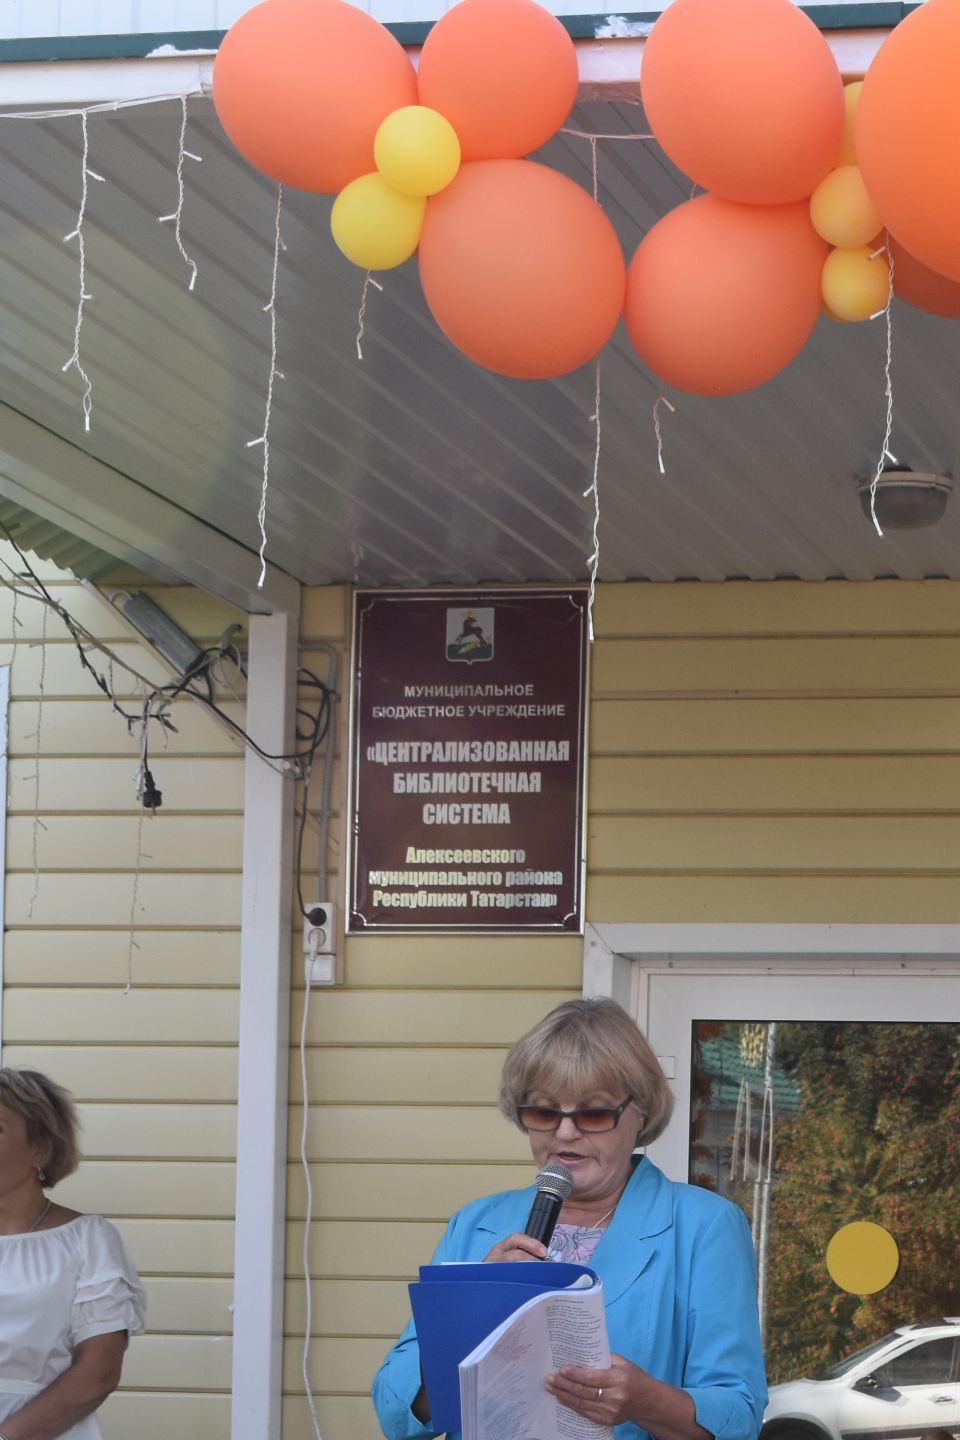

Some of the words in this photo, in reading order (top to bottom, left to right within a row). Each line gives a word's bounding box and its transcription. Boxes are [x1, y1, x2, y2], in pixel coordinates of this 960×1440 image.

[404, 685, 534, 698] МУНИЦИПАЛЬНОЕ
[372, 705, 465, 719] БЮДЖЕТНОЕ
[468, 705, 566, 717] УЧРЕЖДЕНИЕ
[367, 741, 570, 764] «ЦЕНТРАЛИЗОВАННАЯ
[393, 772, 541, 794] БИБЛИОТЕЧНАЯ
[422, 803, 510, 825] СИСТЕМА
[406, 847, 525, 864] Алексеевского
[368, 870, 503, 886] муниципального
[505, 868, 563, 885] района
[373, 891, 468, 908] Республики
[470, 893, 557, 908] Татарстан»
